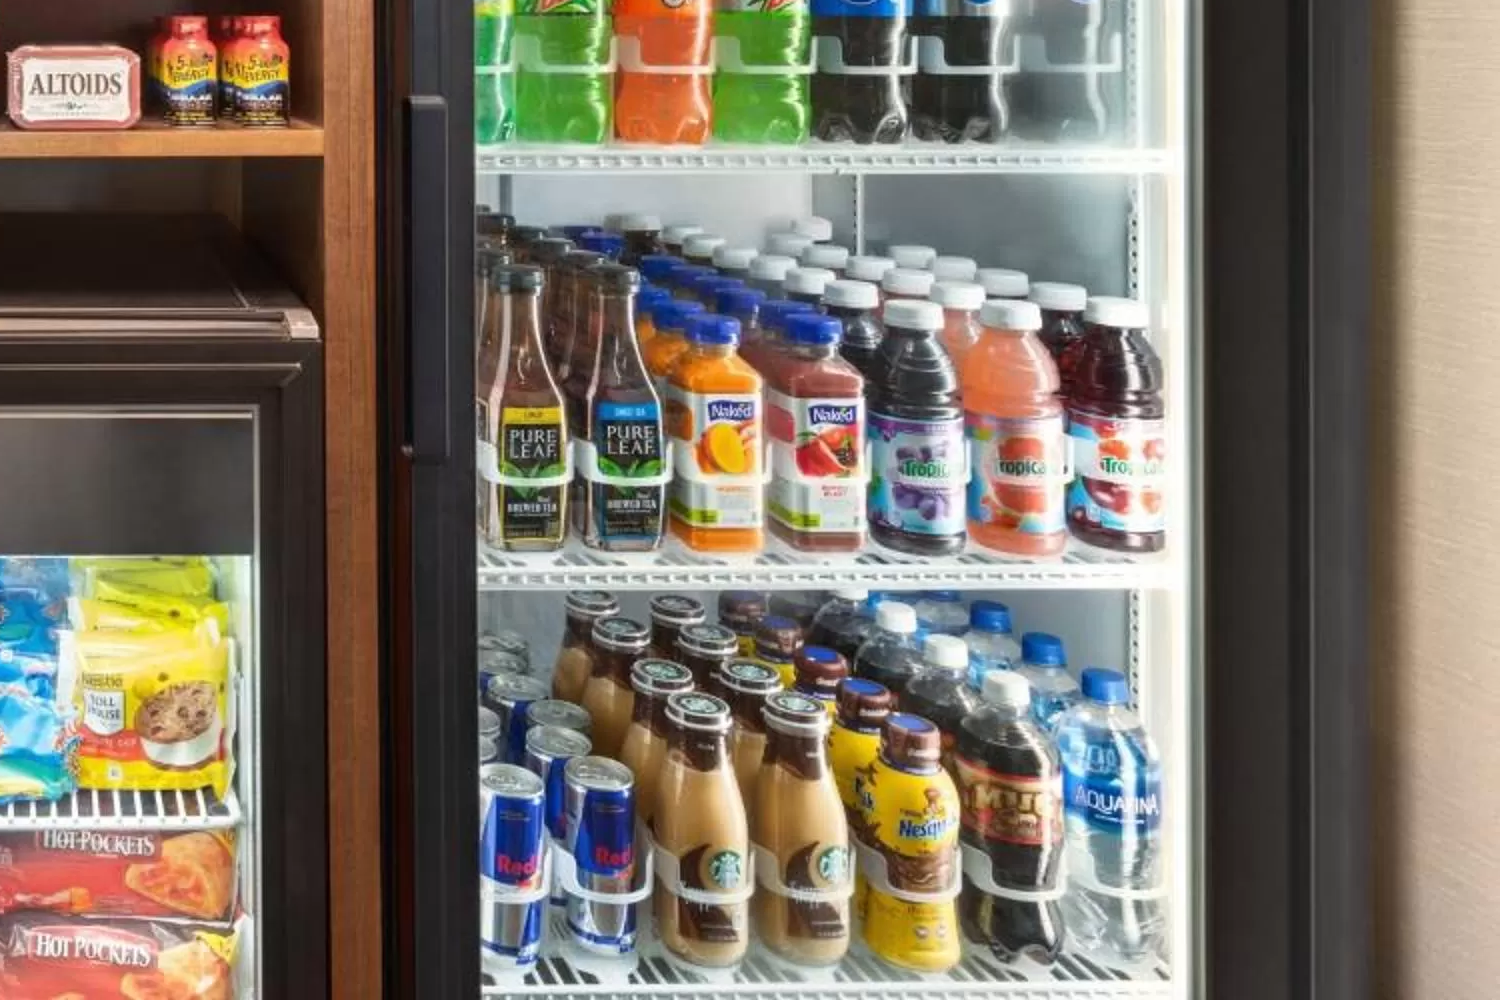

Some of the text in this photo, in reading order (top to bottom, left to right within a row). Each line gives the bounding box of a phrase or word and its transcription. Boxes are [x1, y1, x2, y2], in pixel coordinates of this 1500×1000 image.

[30, 71, 122, 97] ALTOIDS
[711, 401, 754, 418] Naked
[813, 406, 856, 423] Naked
[509, 428, 558, 444] PURE
[607, 424, 656, 440] PURE
[510, 444, 558, 460] LEAF
[607, 440, 656, 456] LEAF
[43, 830, 156, 858] HOT POCKETS
[497, 854, 535, 877] Red
[596, 847, 632, 867] Red
[36, 933, 152, 968] HOT POCKETS
